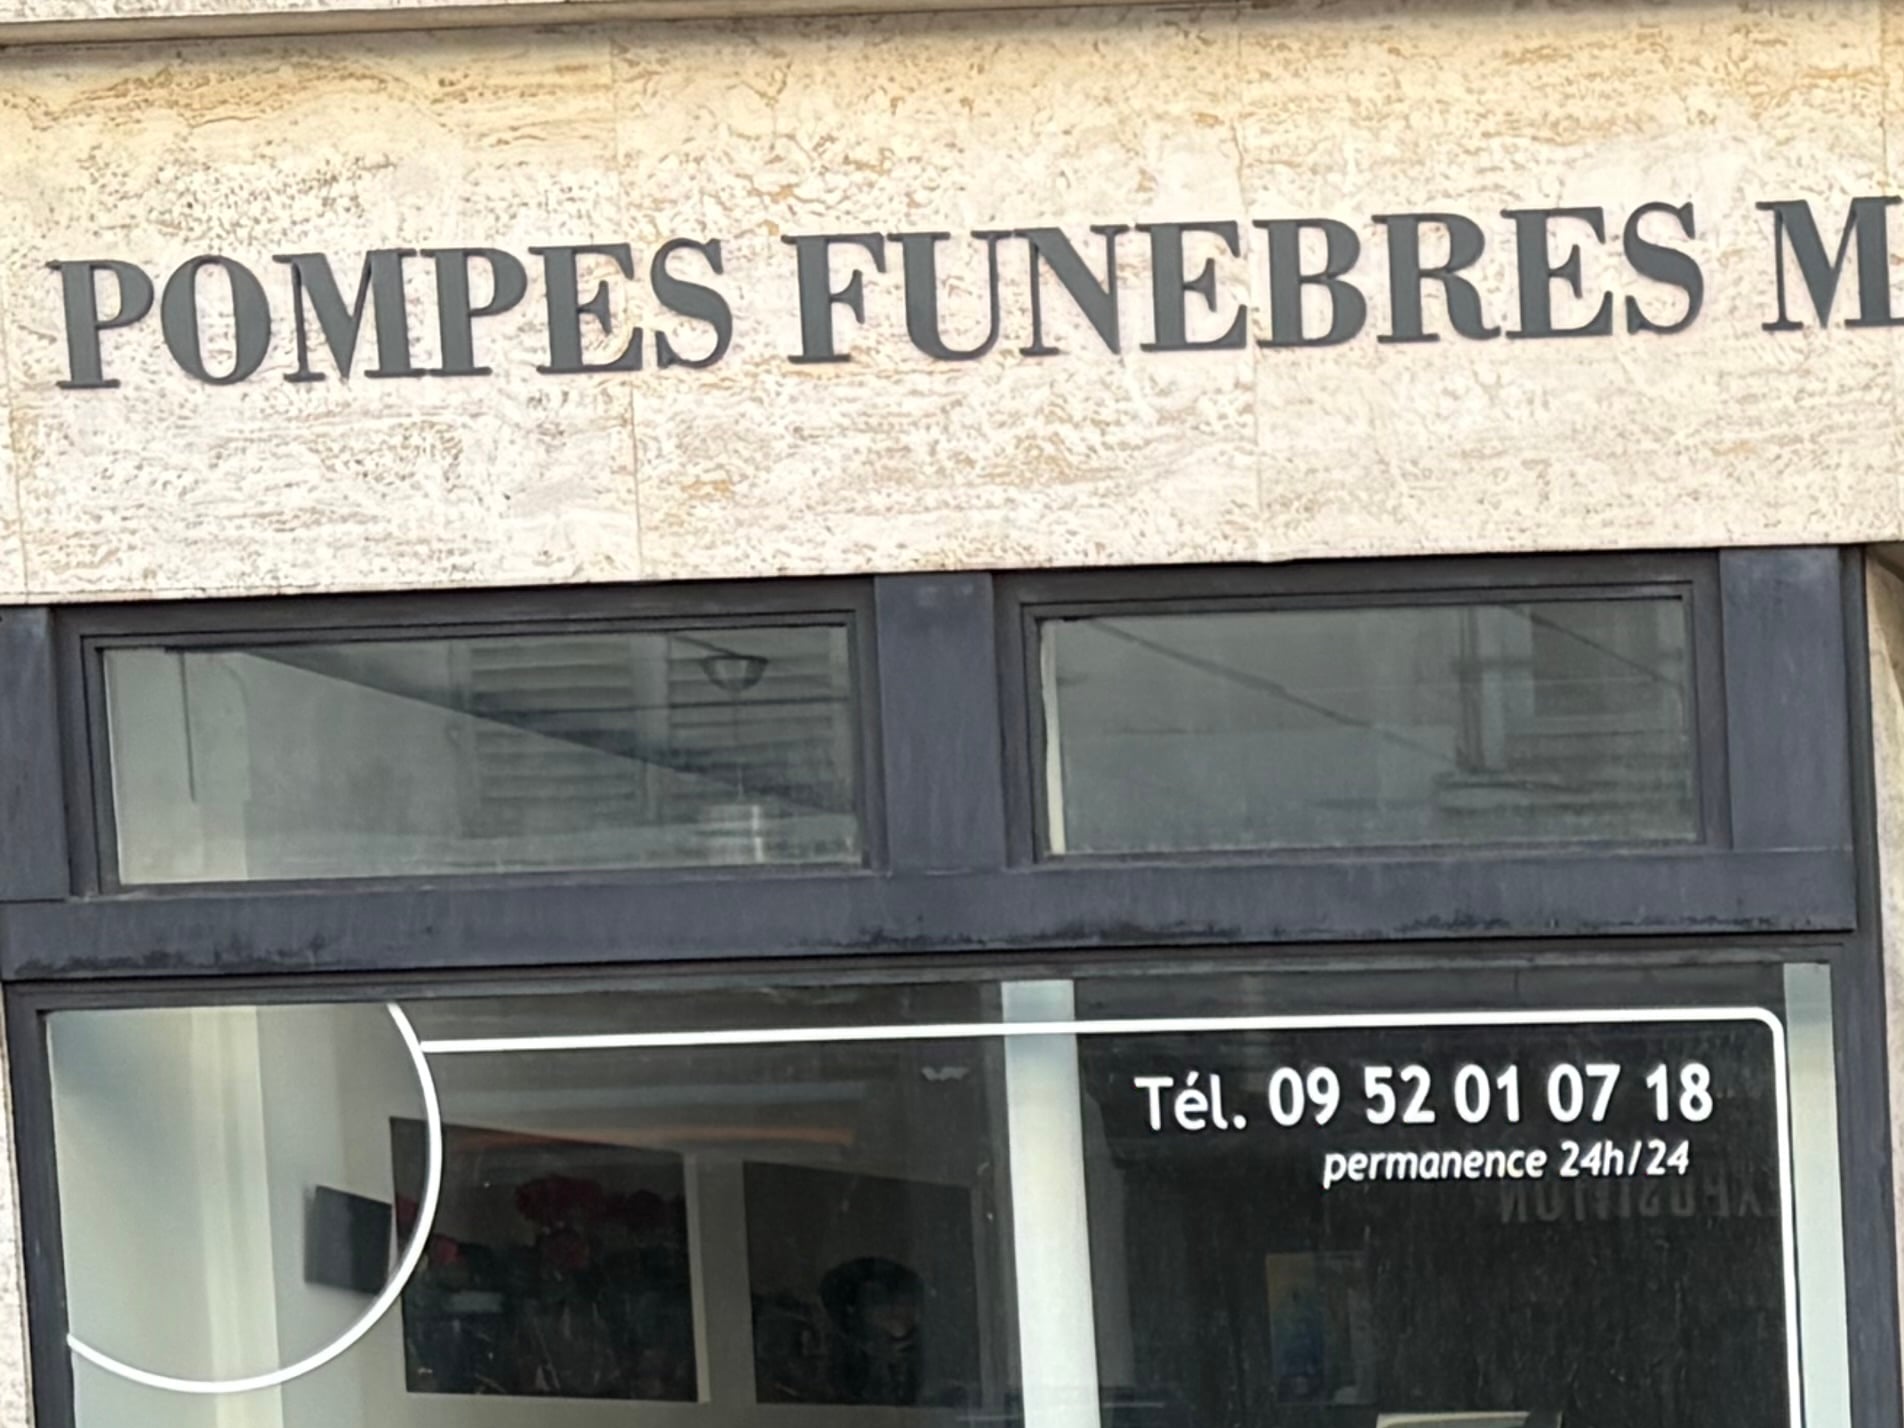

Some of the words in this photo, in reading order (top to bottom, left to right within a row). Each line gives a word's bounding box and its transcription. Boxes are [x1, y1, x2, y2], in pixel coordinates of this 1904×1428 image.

[46, 238, 734, 389] POMPES
[781, 201, 1706, 362] FUNEBRES
[1135, 1076, 1246, 1132] Tél.
[1269, 1068, 1341, 1127] 09
[1364, 1067, 1435, 1125] 52
[1455, 1065, 1522, 1124] 01
[1548, 1064, 1621, 1123] 07
[1647, 1063, 1713, 1121] 18
[1322, 1144, 1545, 1189] permanence
[1560, 1140, 1691, 1177] 24h/24
